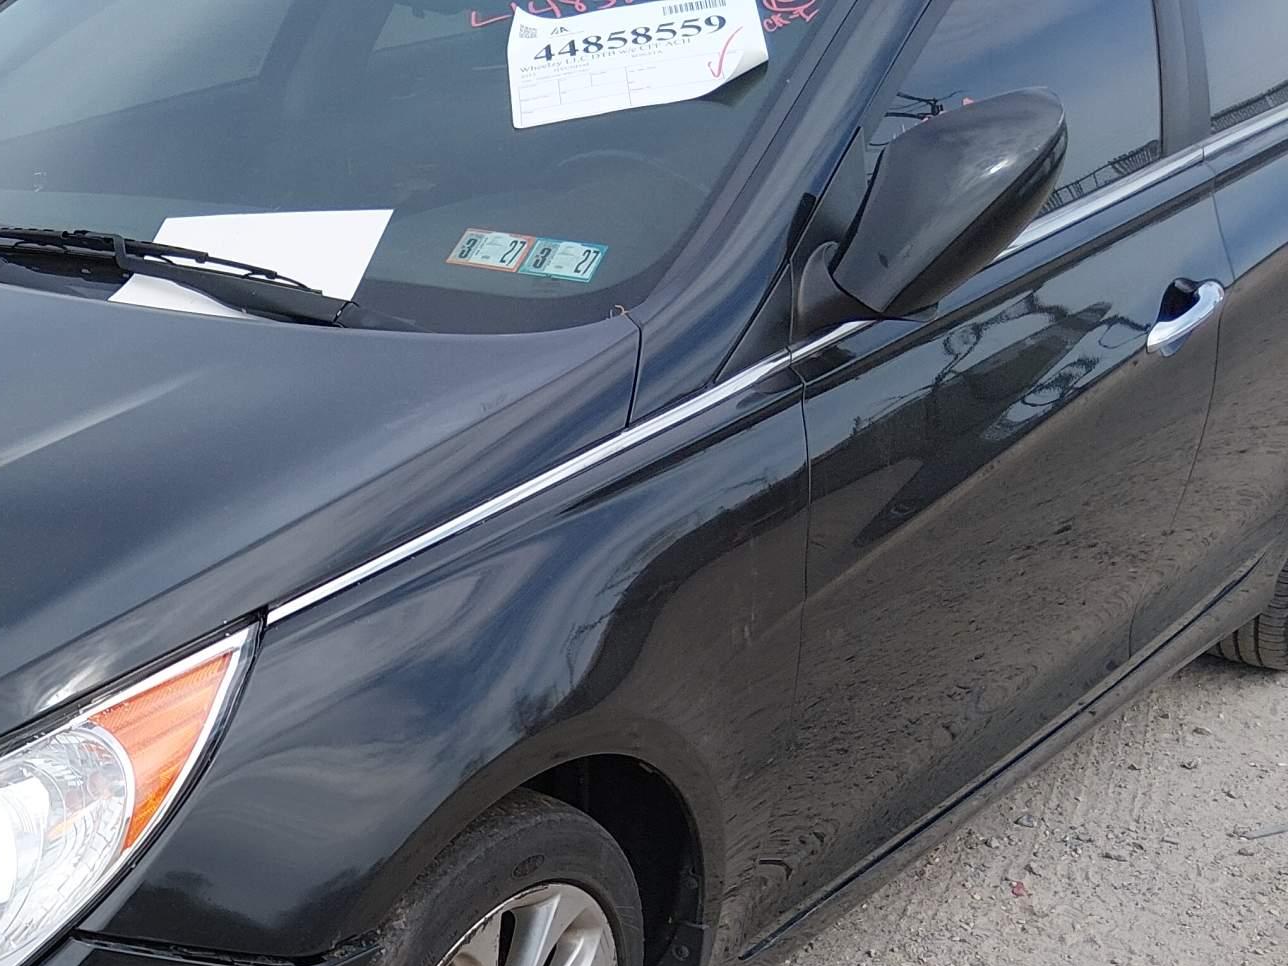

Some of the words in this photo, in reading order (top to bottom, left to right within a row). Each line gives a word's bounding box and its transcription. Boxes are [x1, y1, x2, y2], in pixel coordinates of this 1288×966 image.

[534, 15, 727, 62] 44858559
[458, 238, 478, 259] 3
[500, 240, 527, 266] 27
[533, 247, 552, 269] 3
[574, 249, 601, 276] 27
